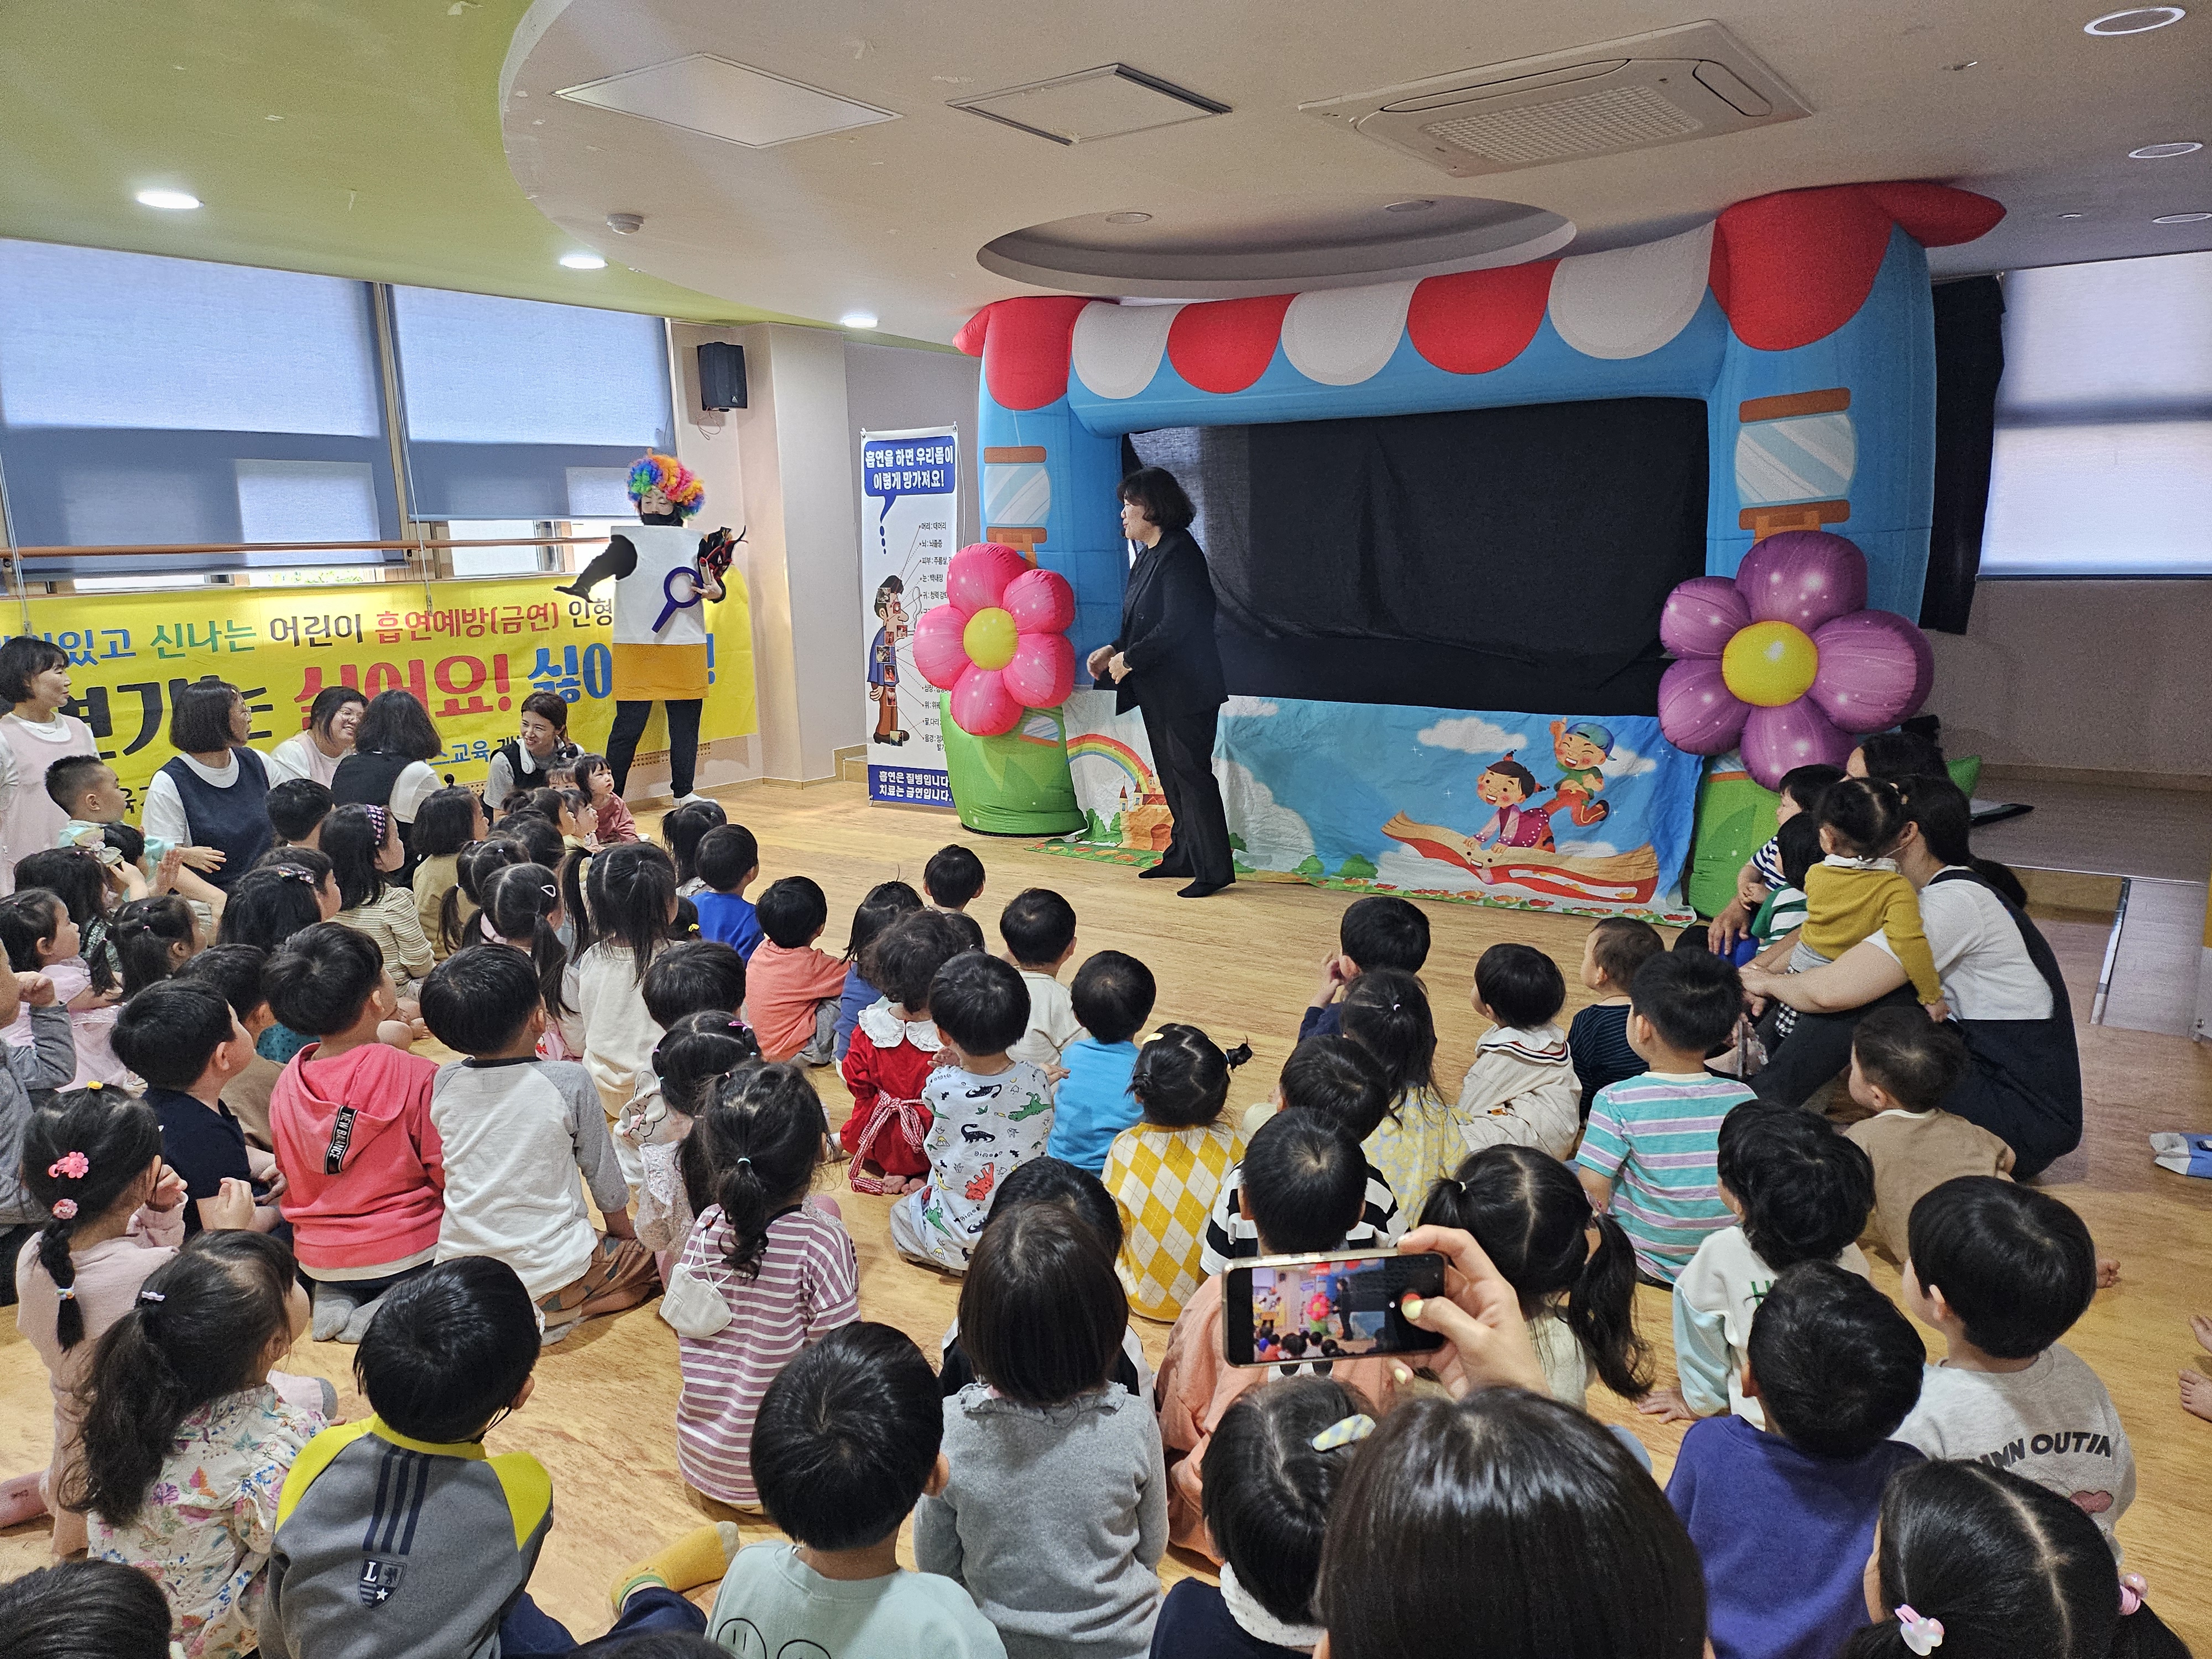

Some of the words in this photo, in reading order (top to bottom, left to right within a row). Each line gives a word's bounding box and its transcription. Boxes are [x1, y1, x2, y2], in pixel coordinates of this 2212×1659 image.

[865, 449, 894, 468] 흡연을
[895, 448, 914, 467] 하면
[873, 472, 901, 490] 이렇게
[902, 469, 945, 489] 망가져요!
[150, 619, 257, 660] 신나는
[269, 613, 363, 648] 어린이
[375, 602, 559, 644] 흡연예방(금연)
[879, 770, 905, 784] 흡연은
[879, 784, 905, 797] 치료는
[906, 786, 952, 802] 금연입니다.
[338, 1112, 352, 1129] NEW
[329, 1129, 347, 1160] BALANCE
[363, 1561, 377, 1582] L
